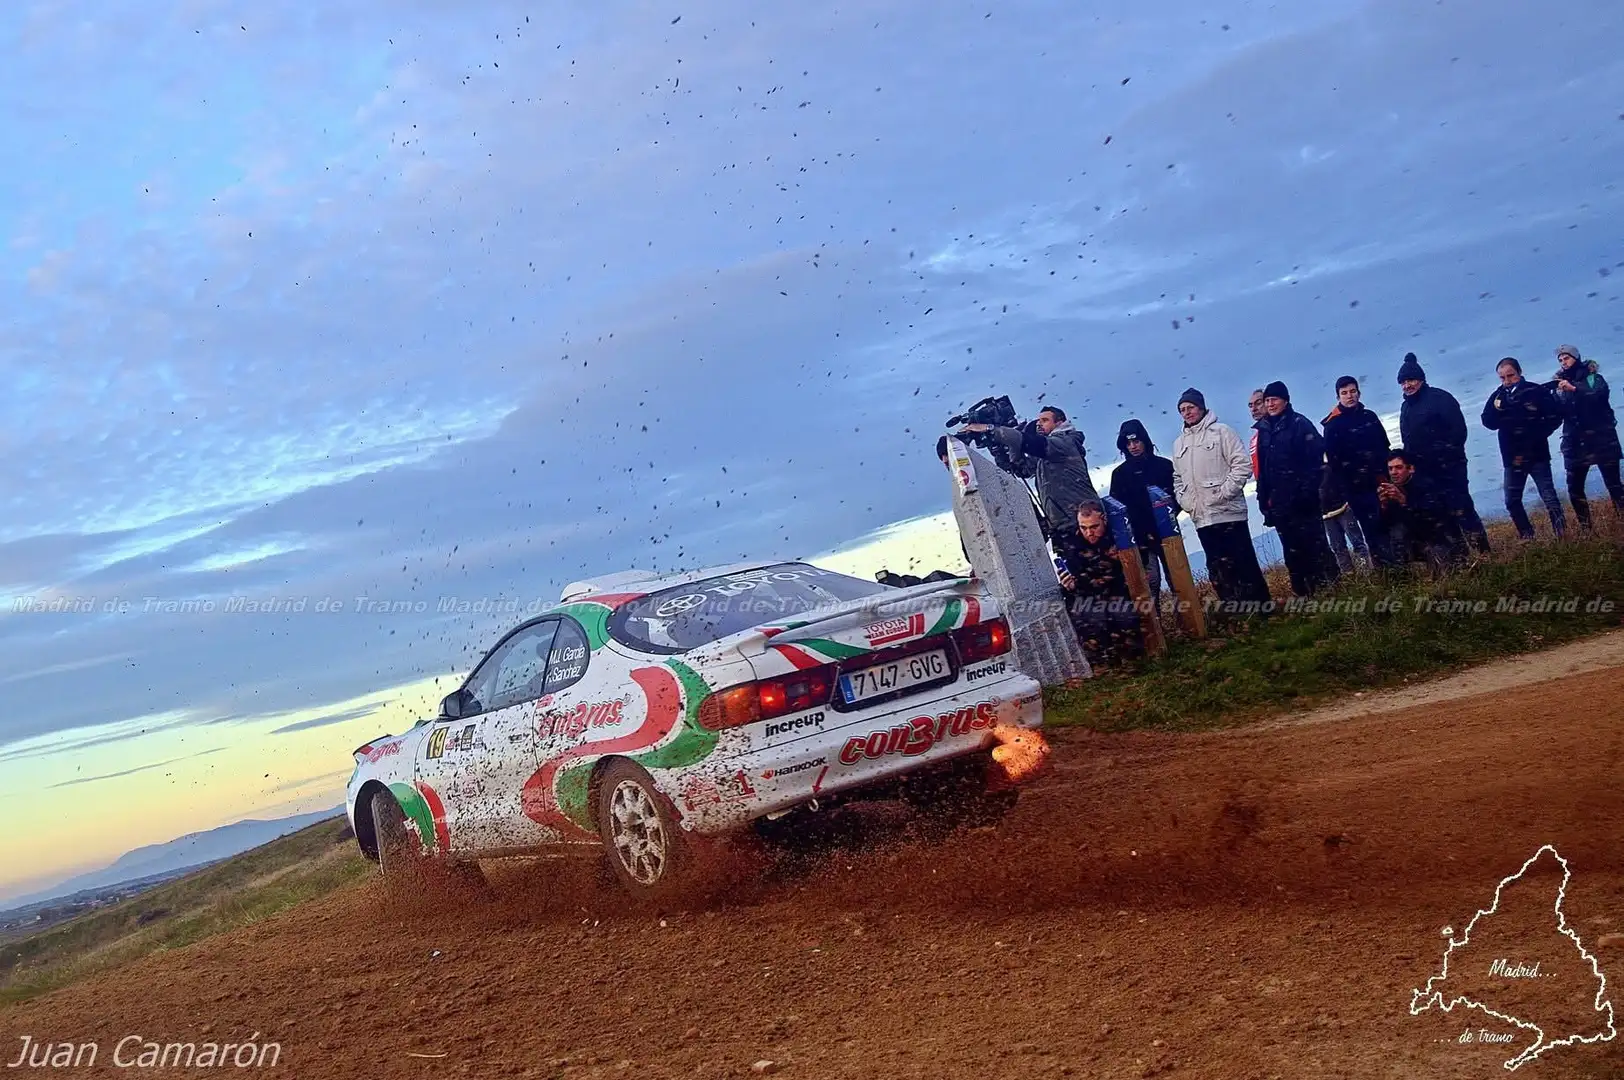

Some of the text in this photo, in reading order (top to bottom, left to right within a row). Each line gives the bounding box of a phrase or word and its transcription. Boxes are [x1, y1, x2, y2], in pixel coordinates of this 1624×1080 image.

[864, 618, 907, 634] TOYOTA
[854, 654, 943, 696] 7147 GVG
[967, 660, 1006, 682] increup
[765, 710, 826, 738] increup
[429, 727, 447, 757] 19
